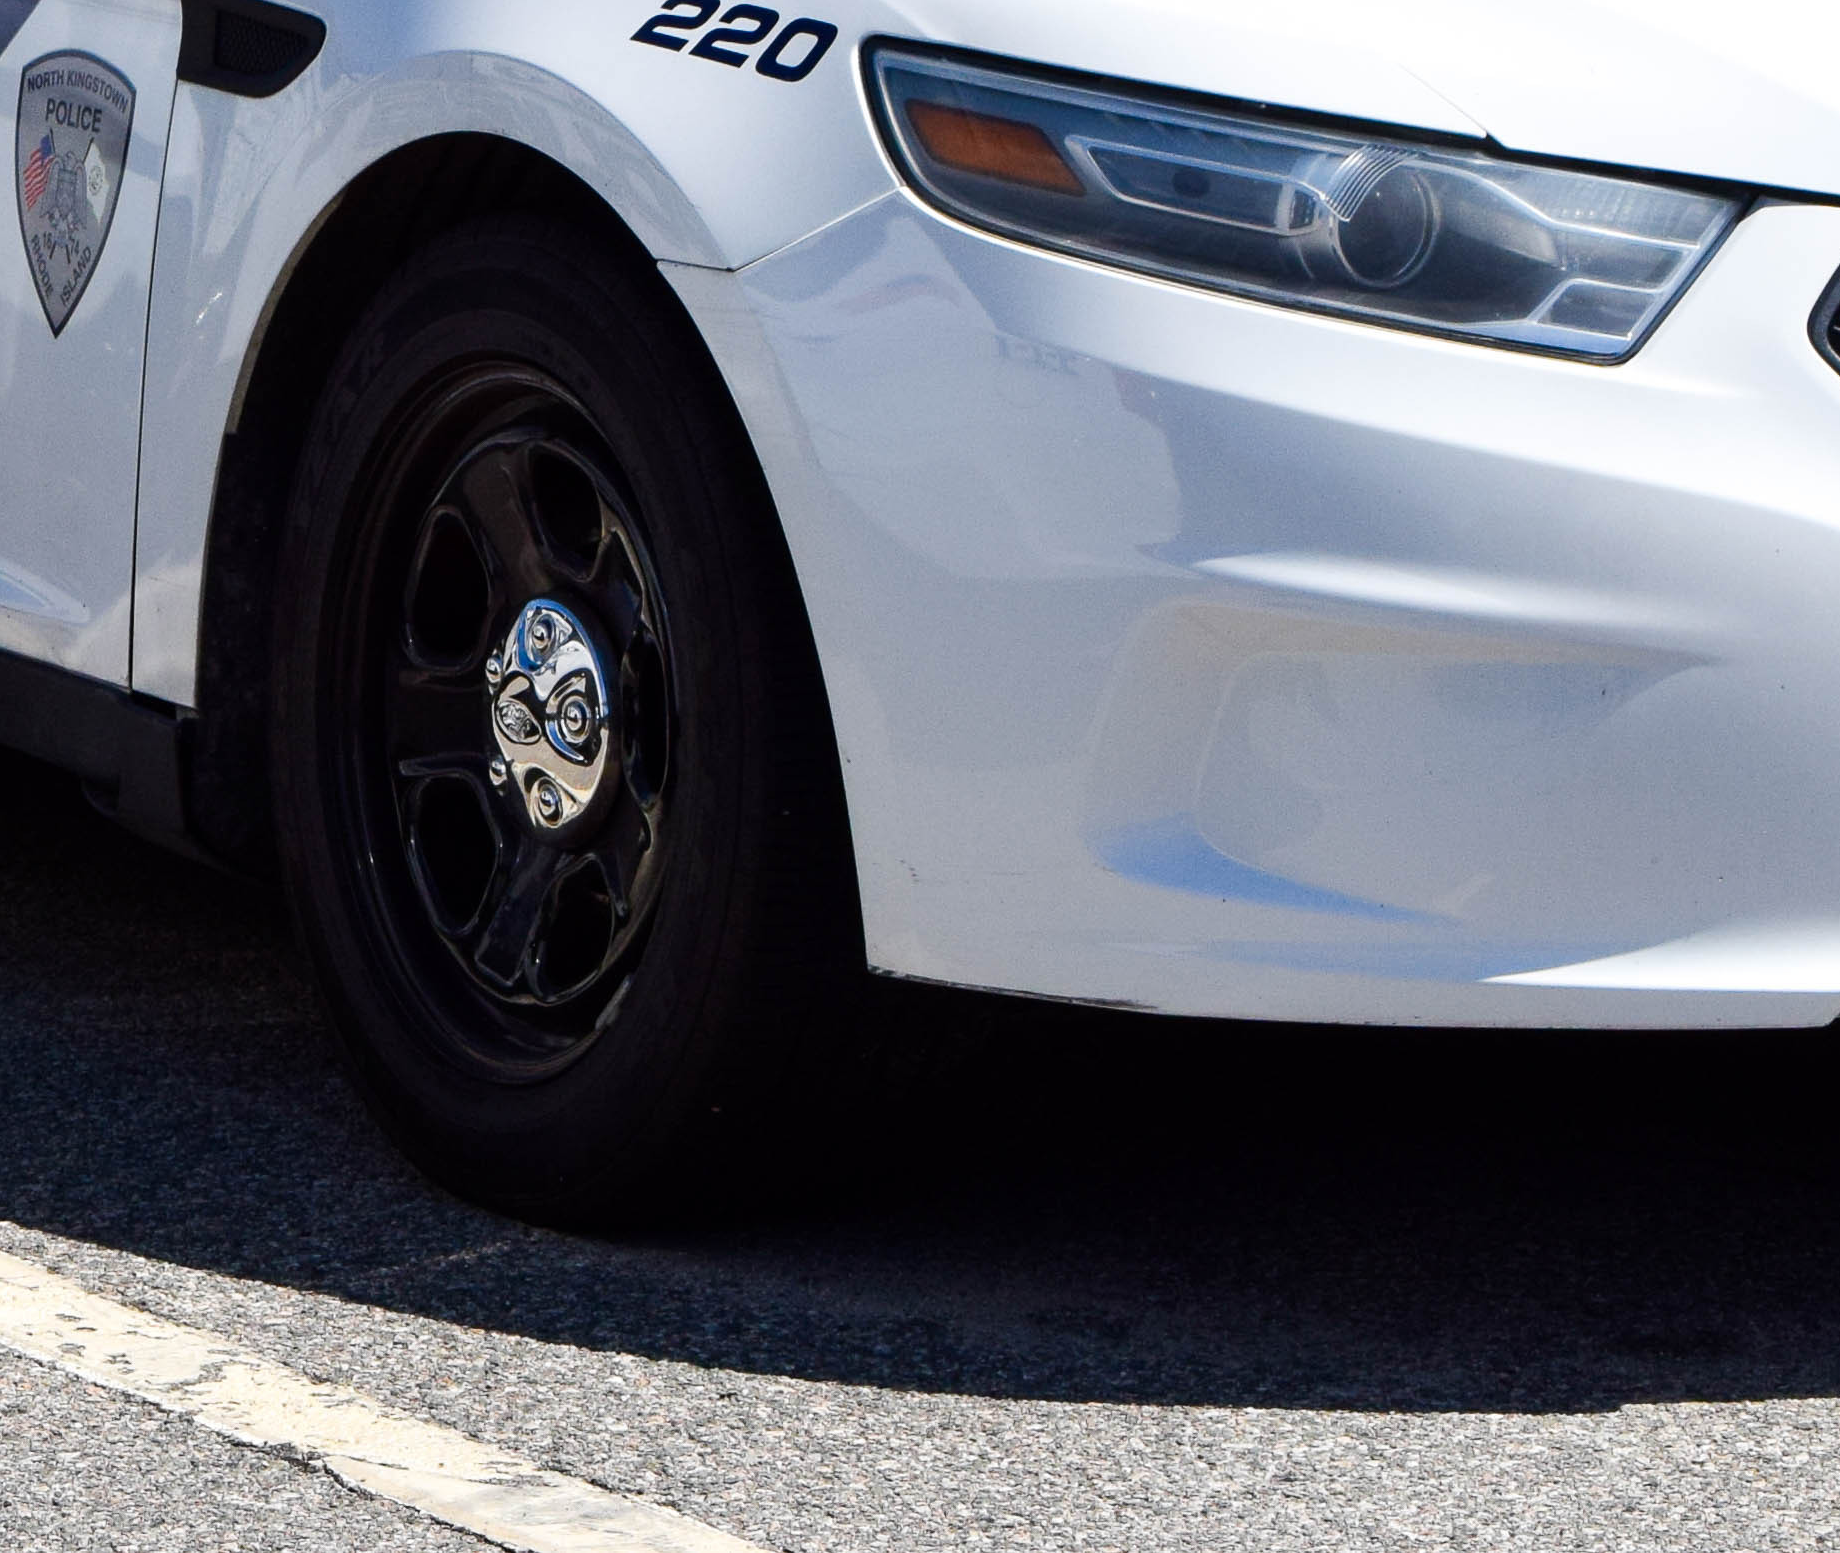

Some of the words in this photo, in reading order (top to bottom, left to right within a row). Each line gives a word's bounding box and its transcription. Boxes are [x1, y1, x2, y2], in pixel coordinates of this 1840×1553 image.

[27, 69, 64, 93] NORTH
[67, 70, 128, 114] KINGSTOWN
[46, 98, 102, 133] POLICE
[30, 234, 54, 299] RHODE
[60, 246, 92, 306] ISLAND
